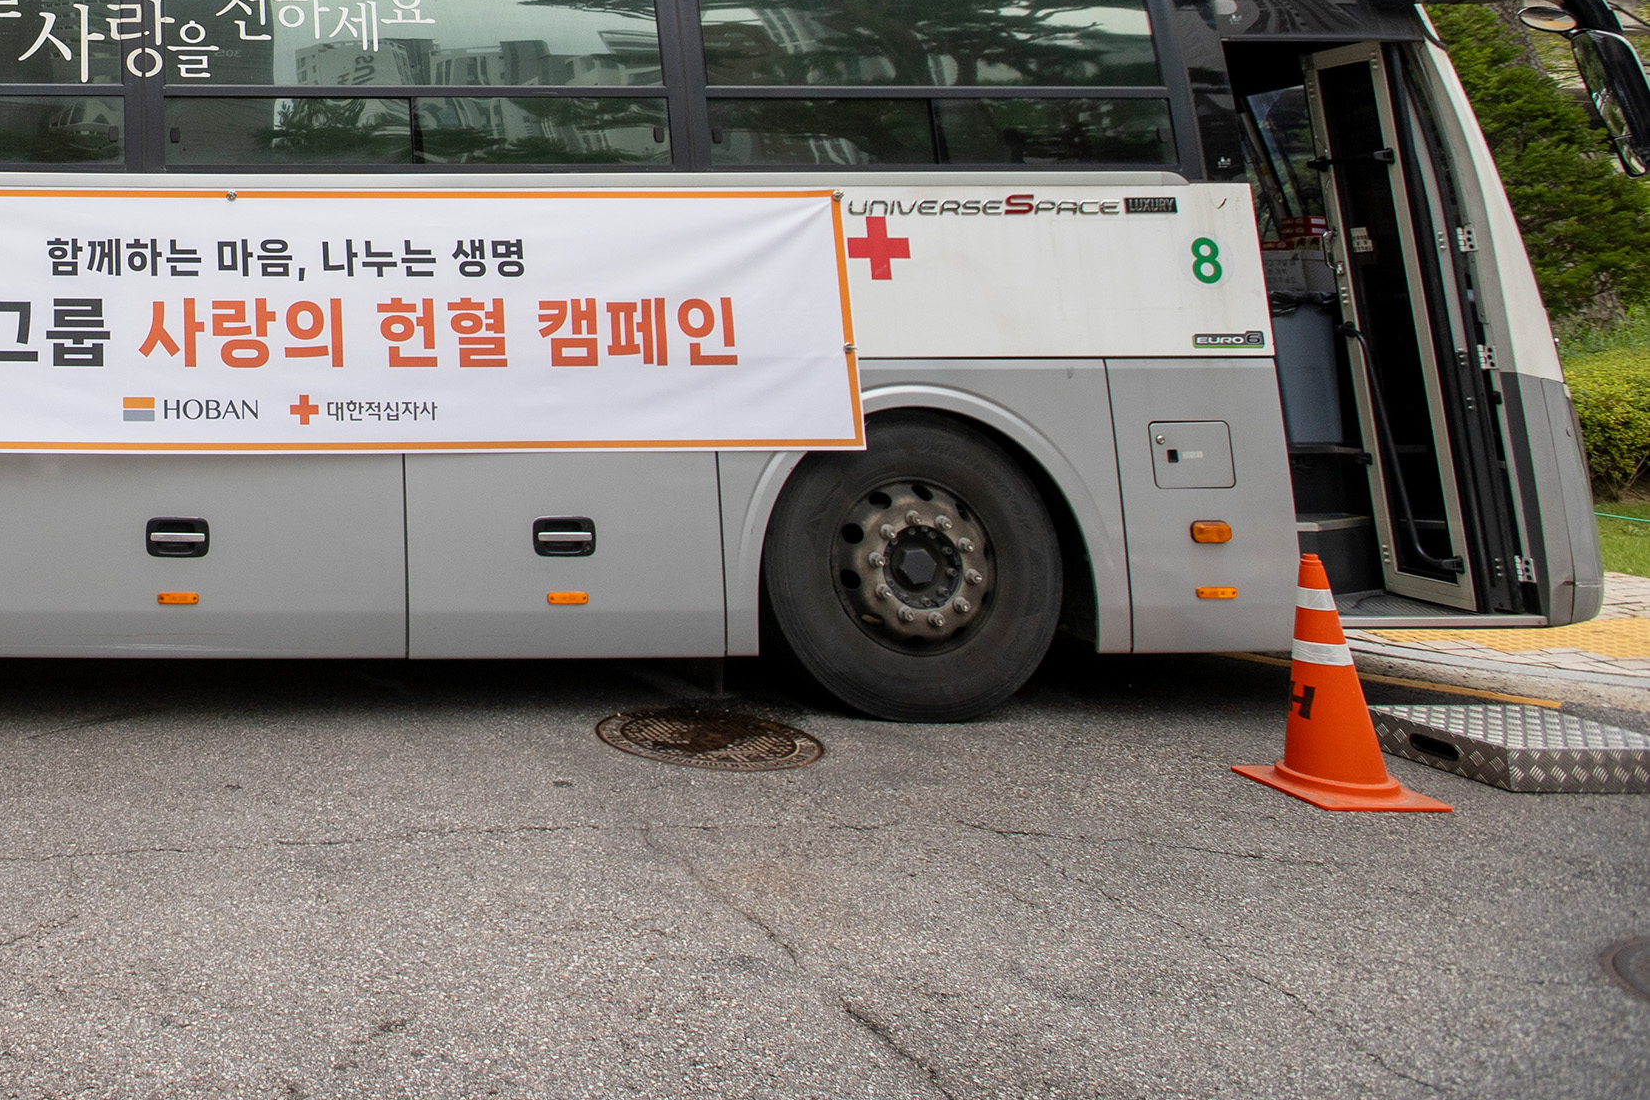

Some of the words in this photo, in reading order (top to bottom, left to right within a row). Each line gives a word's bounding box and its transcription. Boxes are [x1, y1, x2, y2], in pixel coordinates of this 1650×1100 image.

[1128, 199, 1173, 212] LUXURY
[47, 238, 201, 276] 함께하는
[218, 239, 305, 281] 마음,
[322, 239, 436, 277] 나누는
[452, 239, 525, 277] 생명
[1192, 237, 1223, 284] 8
[139, 298, 344, 368] 사랑의
[376, 298, 508, 367] 헌혈
[538, 297, 738, 367] 캠페인
[163, 399, 259, 420] HOBAN
[326, 400, 438, 422] 대한적십자사
